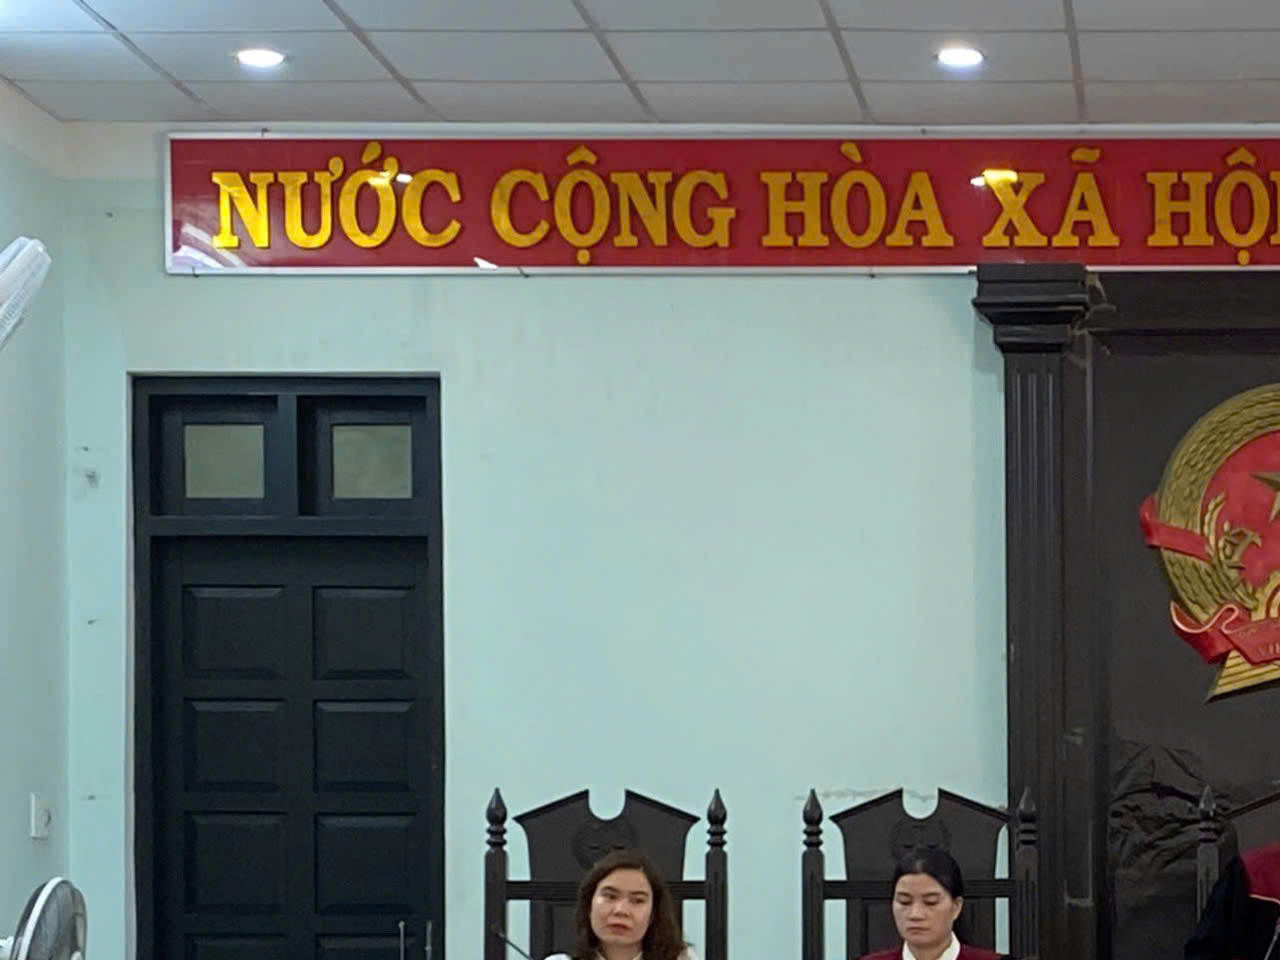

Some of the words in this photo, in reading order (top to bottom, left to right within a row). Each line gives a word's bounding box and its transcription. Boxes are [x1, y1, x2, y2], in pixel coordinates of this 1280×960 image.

[212, 140, 462, 250] NƯỚC
[490, 144, 737, 264] CỘNG
[759, 140, 953, 248] HÒA
[978, 146, 1120, 249] XÃ
